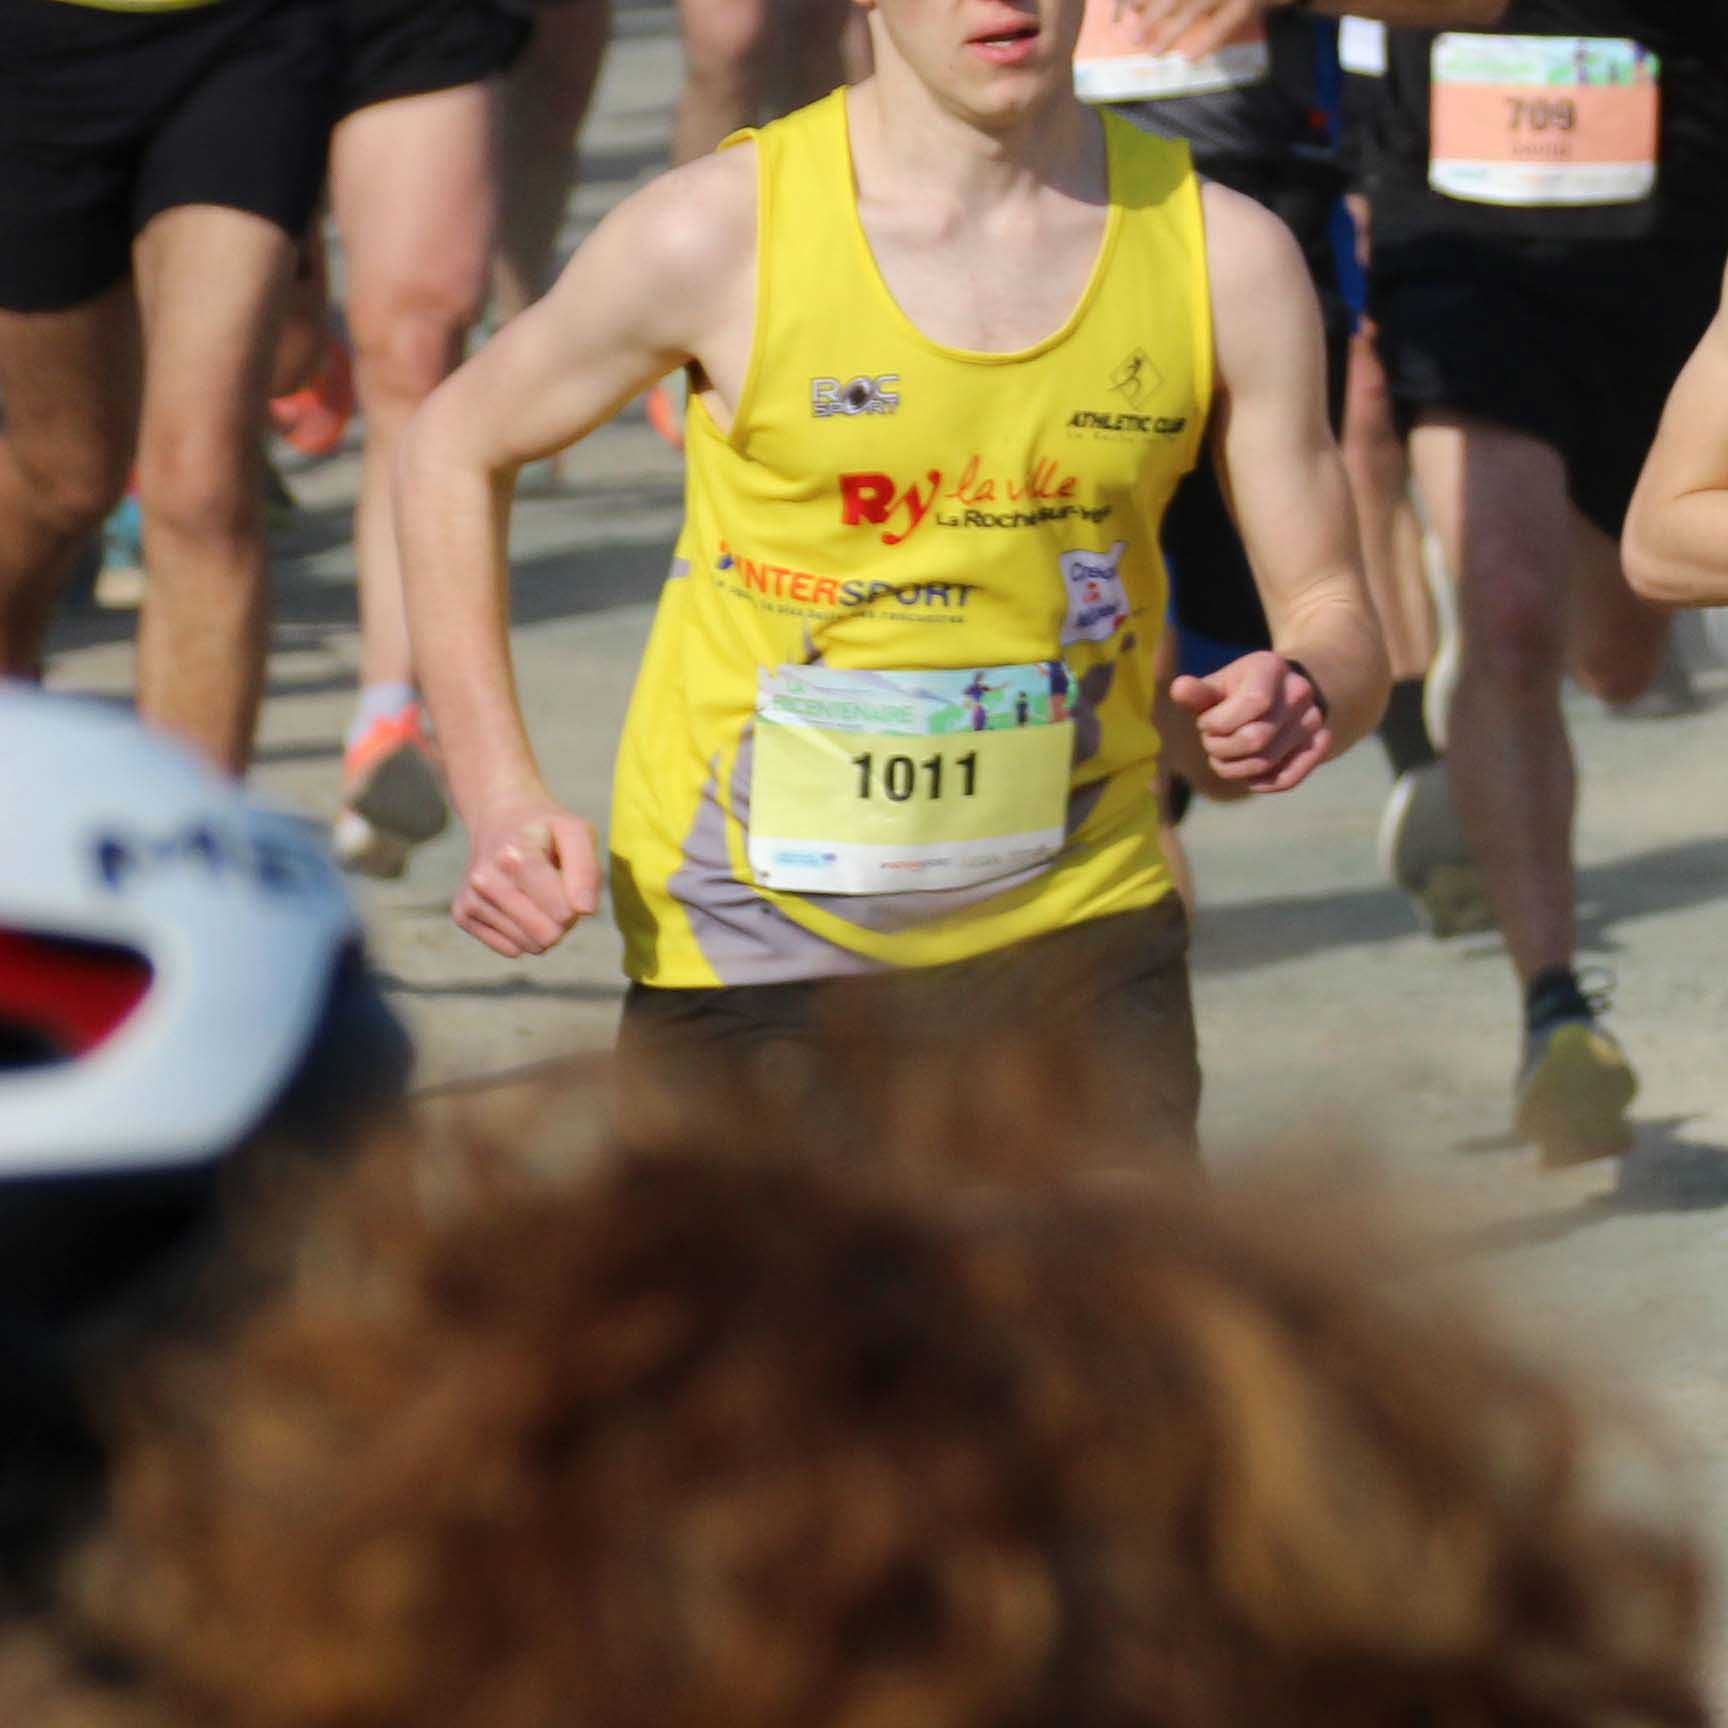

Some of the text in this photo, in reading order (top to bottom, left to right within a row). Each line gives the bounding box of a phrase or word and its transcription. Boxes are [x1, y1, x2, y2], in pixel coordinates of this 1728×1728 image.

[811, 375, 899, 407] ROC
[839, 470, 942, 545] Ry
[943, 453, 995, 506] la
[735, 552, 976, 609] INTERSPORT
[852, 751, 978, 802] 1011
